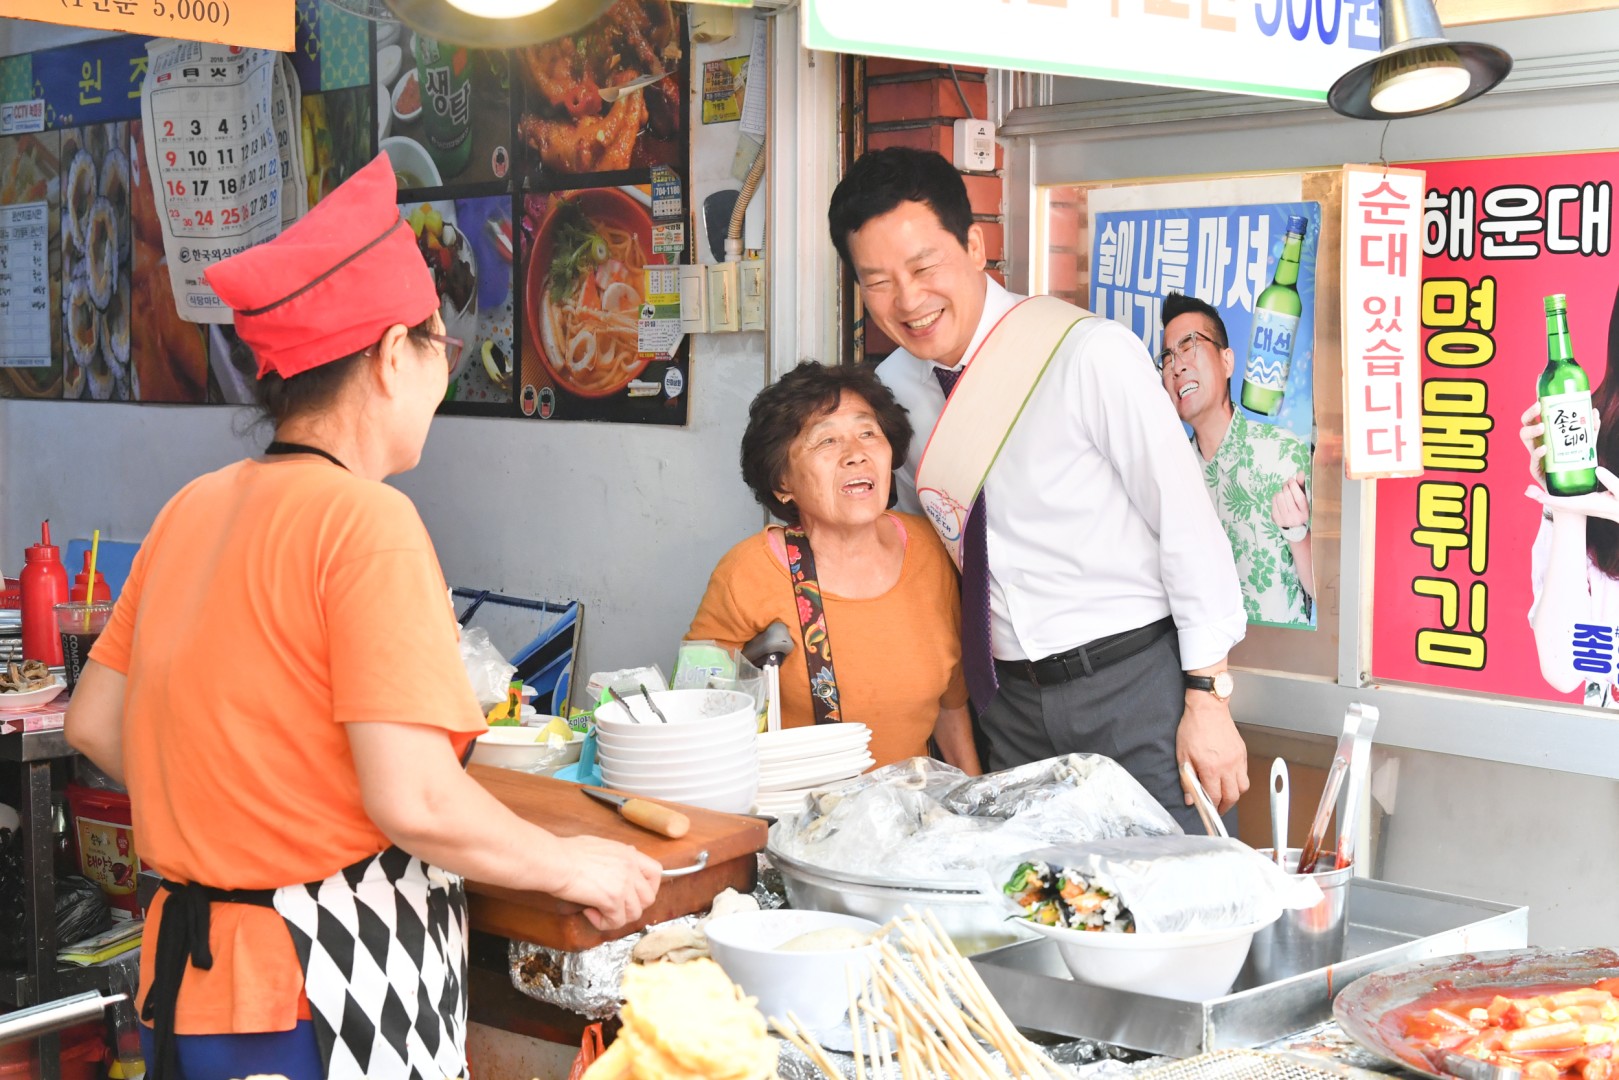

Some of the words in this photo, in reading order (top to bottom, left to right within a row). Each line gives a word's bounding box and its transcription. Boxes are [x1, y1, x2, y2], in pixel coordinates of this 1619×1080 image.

[183, 68, 199, 78] 月
[211, 68, 226, 78] 火
[163, 120, 175, 136] 2
[190, 120, 202, 136] 3
[218, 119, 229, 134] 4
[242, 115, 248, 131] 5
[278, 130, 288, 148] 20
[166, 151, 176, 166] 9
[189, 150, 207, 166] 10
[217, 149, 234, 164] 11
[241, 144, 249, 161] 12
[250, 138, 258, 156] 13
[260, 133, 267, 150] 14
[167, 180, 186, 196] 16
[192, 180, 209, 196] 17
[219, 178, 238, 194] 18
[248, 168, 256, 186] 20
[258, 163, 266, 181] 21
[268, 158, 277, 177] 22
[169, 210, 180, 218] 23
[195, 210, 214, 226] 24
[220, 208, 240, 225] 25
[250, 198, 258, 216] 27
[260, 194, 268, 212] 28
[269, 189, 278, 208] 29
[183, 218, 192, 227] 30
[1422, 180, 1613, 262] 해운대
[1358, 181, 1410, 277] 순대
[1194, 214, 1270, 314] 마셔
[1254, 325, 1292, 358] 대선
[1362, 295, 1407, 462] 있습니다
[1554, 410, 1582, 434] 좋은
[1564, 428, 1588, 446] 데이
[1572, 623, 1619, 684] 좋
[568, 714, 590, 730] 미양
